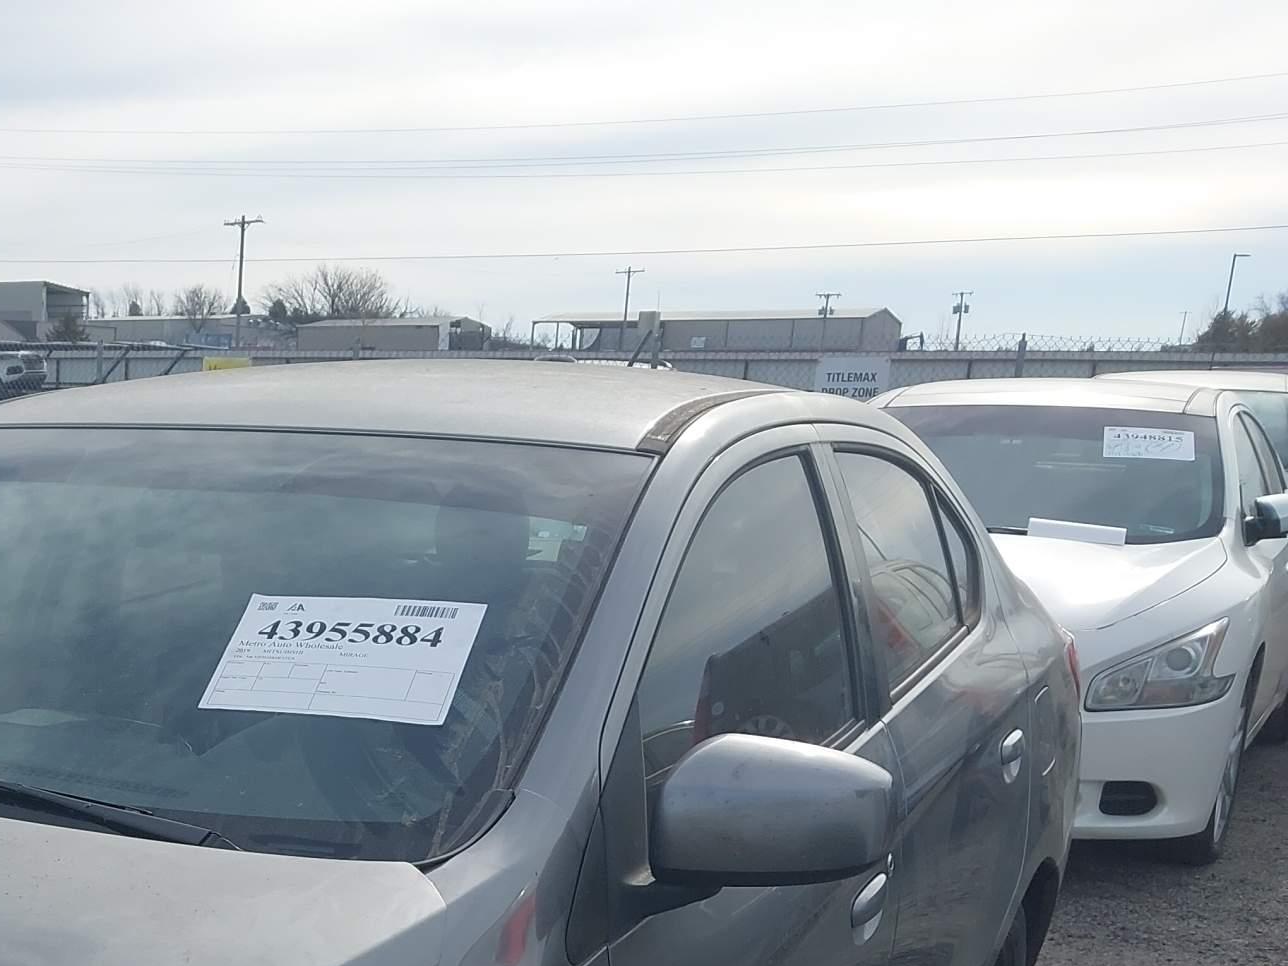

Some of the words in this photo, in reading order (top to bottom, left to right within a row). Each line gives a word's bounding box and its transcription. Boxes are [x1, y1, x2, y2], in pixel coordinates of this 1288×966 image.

[825, 372, 878, 383] TITLEMAX
[851, 387, 879, 398] ZONE
[257, 619, 446, 648] 43955884
[238, 639, 267, 648] Metro
[268, 640, 293, 649] Auto
[295, 641, 344, 651] Wholesale
